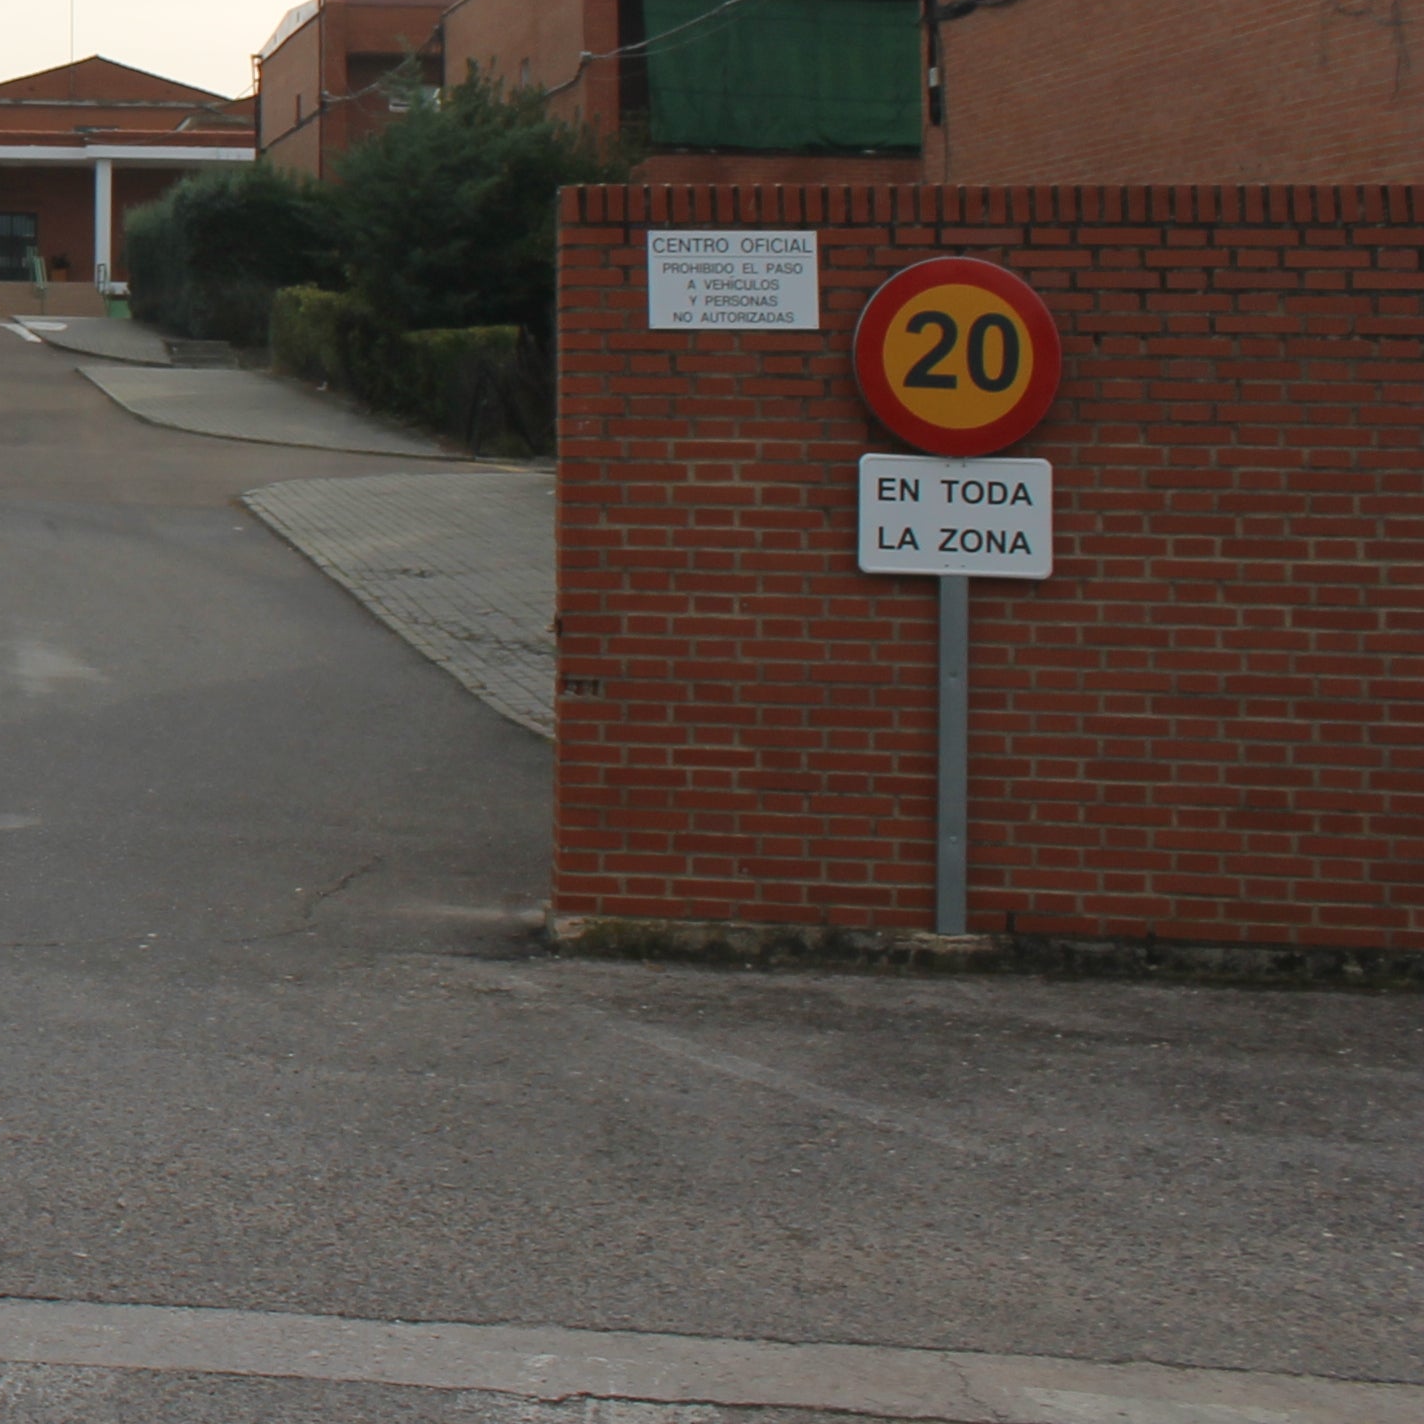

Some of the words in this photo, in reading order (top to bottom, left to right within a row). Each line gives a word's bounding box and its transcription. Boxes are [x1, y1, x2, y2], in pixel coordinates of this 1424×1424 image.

[652, 237, 729, 253] CENTRO
[740, 237, 813, 253] OFICIAL
[662, 262, 734, 274] PROHIBIDO
[742, 262, 758, 274] EL
[766, 262, 803, 274] PASO
[687, 279, 697, 290] A
[689, 295, 697, 306] Y
[704, 295, 778, 307] PERSONAS
[672, 311, 693, 323] NO
[700, 311, 794, 323] AUTORIZADAS
[902, 310, 1020, 393] 20
[877, 477, 920, 503] EN
[940, 479, 1033, 507] TODA
[877, 526, 919, 551] LA
[938, 528, 1032, 555] ZONA
